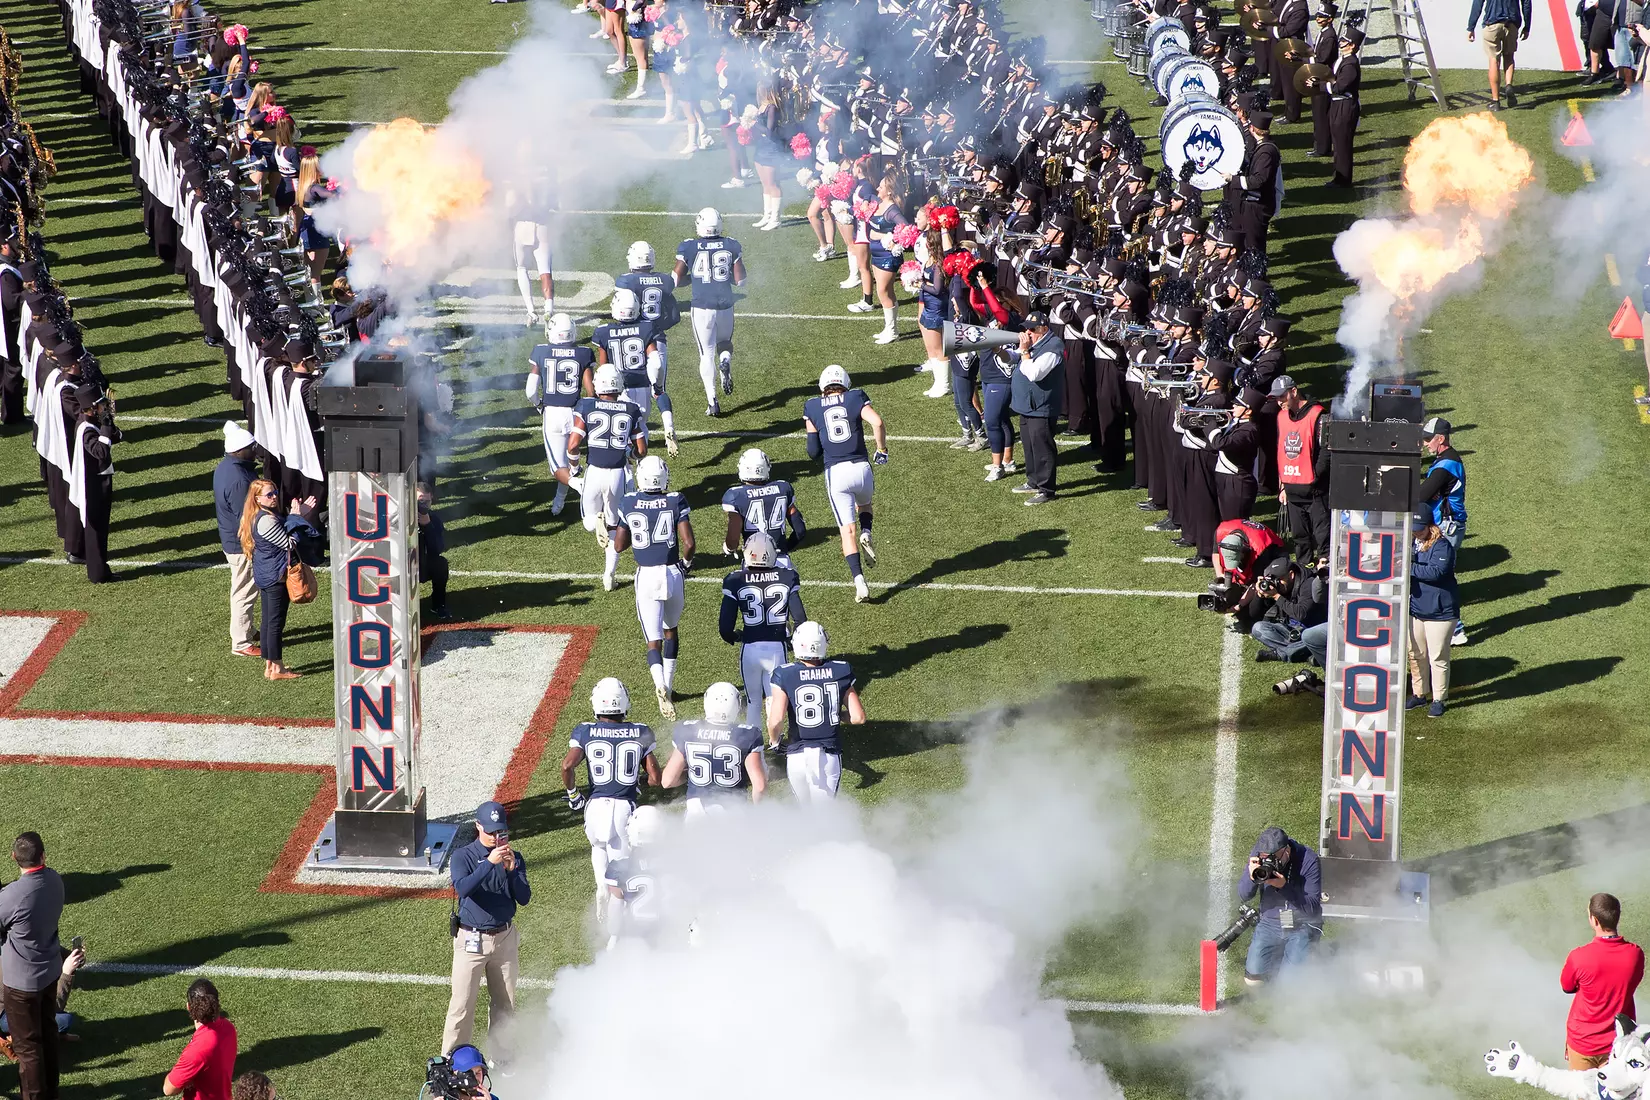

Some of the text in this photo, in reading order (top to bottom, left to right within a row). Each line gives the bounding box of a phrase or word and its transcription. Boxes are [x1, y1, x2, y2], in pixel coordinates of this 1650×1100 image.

[639, 277, 664, 285] FERRELL
[692, 250, 733, 284] 48
[641, 287, 663, 321] 8
[609, 326, 640, 337] OLANIYAN
[551, 348, 576, 357] TURNER
[607, 337, 645, 372] 18
[544, 358, 580, 395] 13
[594, 401, 627, 412] MORRISON
[587, 411, 633, 450] 29
[823, 405, 852, 444] 6
[1283, 465, 1302, 477] 191
[634, 499, 667, 509] JEFFREYS
[746, 485, 781, 499] SWENSON
[625, 510, 676, 550] 84
[744, 495, 788, 534] 44
[745, 572, 780, 583] LAZARUS
[737, 583, 791, 627] 32
[343, 491, 397, 793] UCONN
[799, 668, 833, 681] GRAHAM
[1337, 531, 1396, 842] UCONN
[795, 681, 840, 729] 81
[589, 727, 640, 738] MAURISSEAU
[697, 729, 731, 741] KEATING
[584, 740, 644, 786] 80
[684, 741, 742, 788] 53
